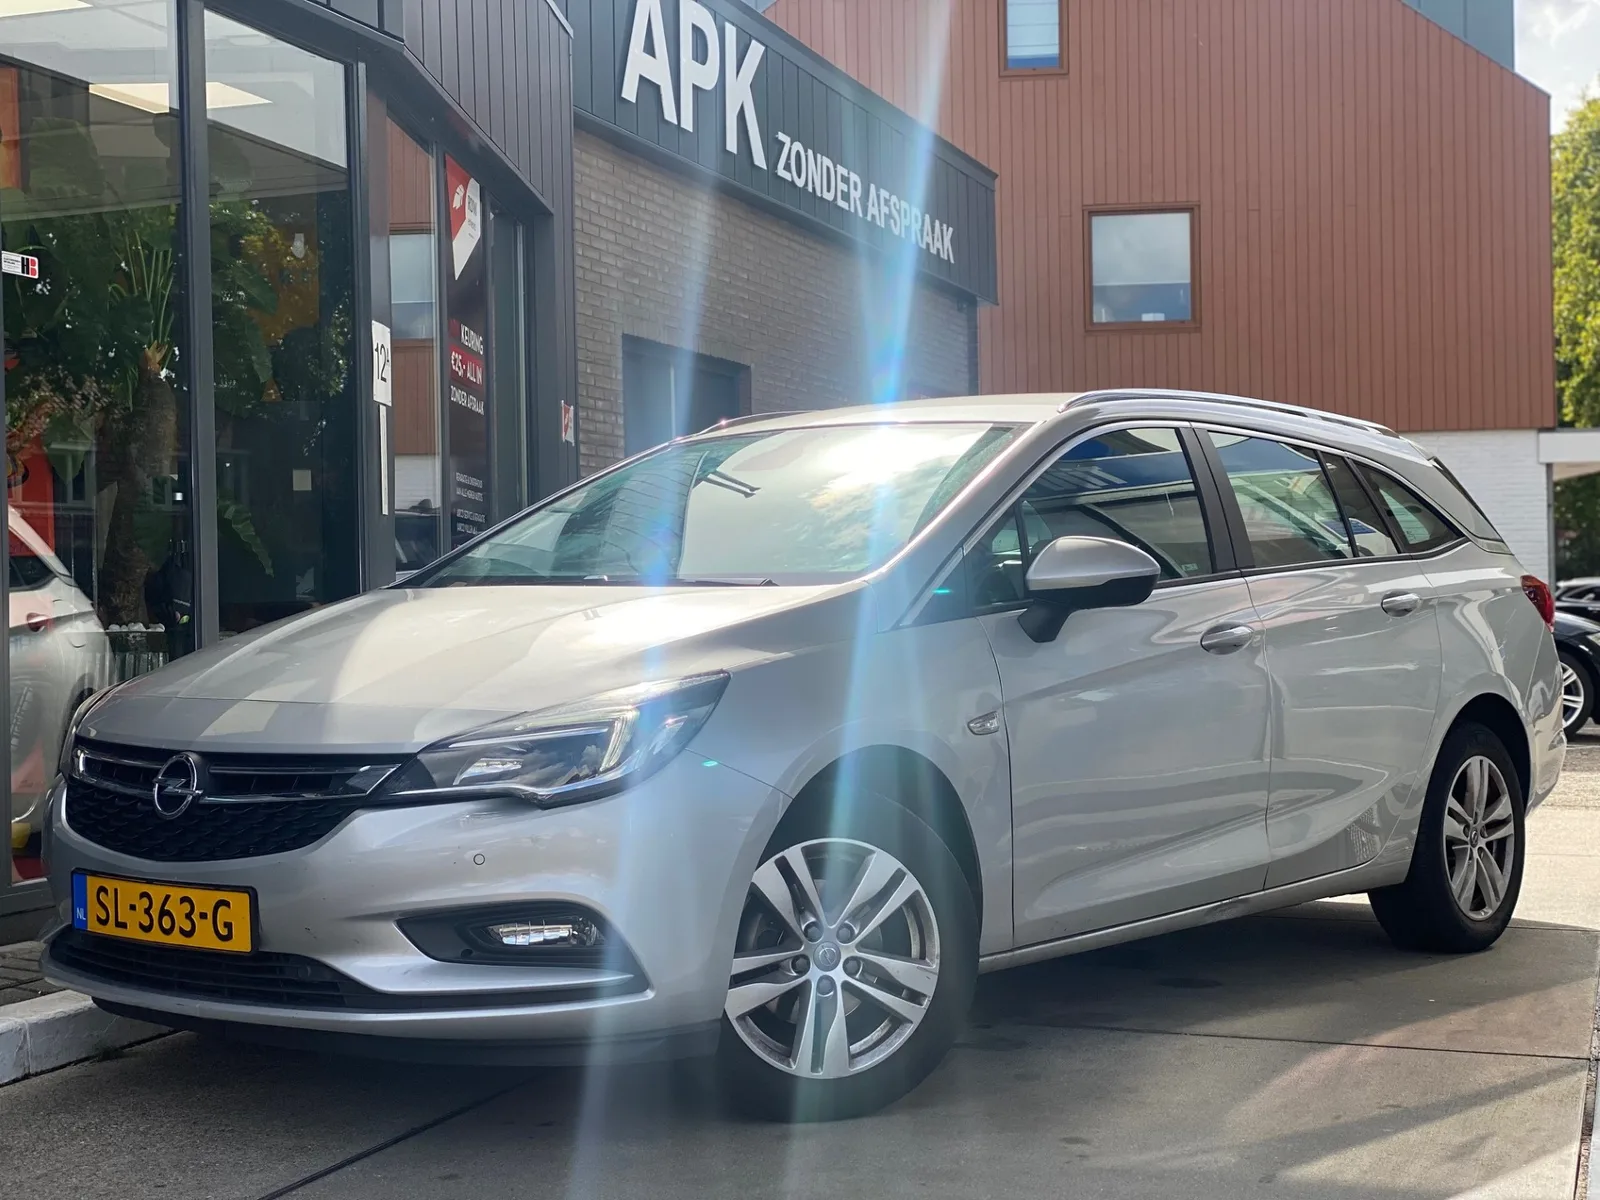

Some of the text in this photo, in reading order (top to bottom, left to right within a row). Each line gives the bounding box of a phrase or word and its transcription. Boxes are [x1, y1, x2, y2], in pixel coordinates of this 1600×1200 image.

[621, 0, 767, 170] APK
[775, 131, 955, 264] ZONDER AFSPRAAK
[460, 323, 484, 355] KEURING
[76, 885, 234, 942] NL SL-363-G
